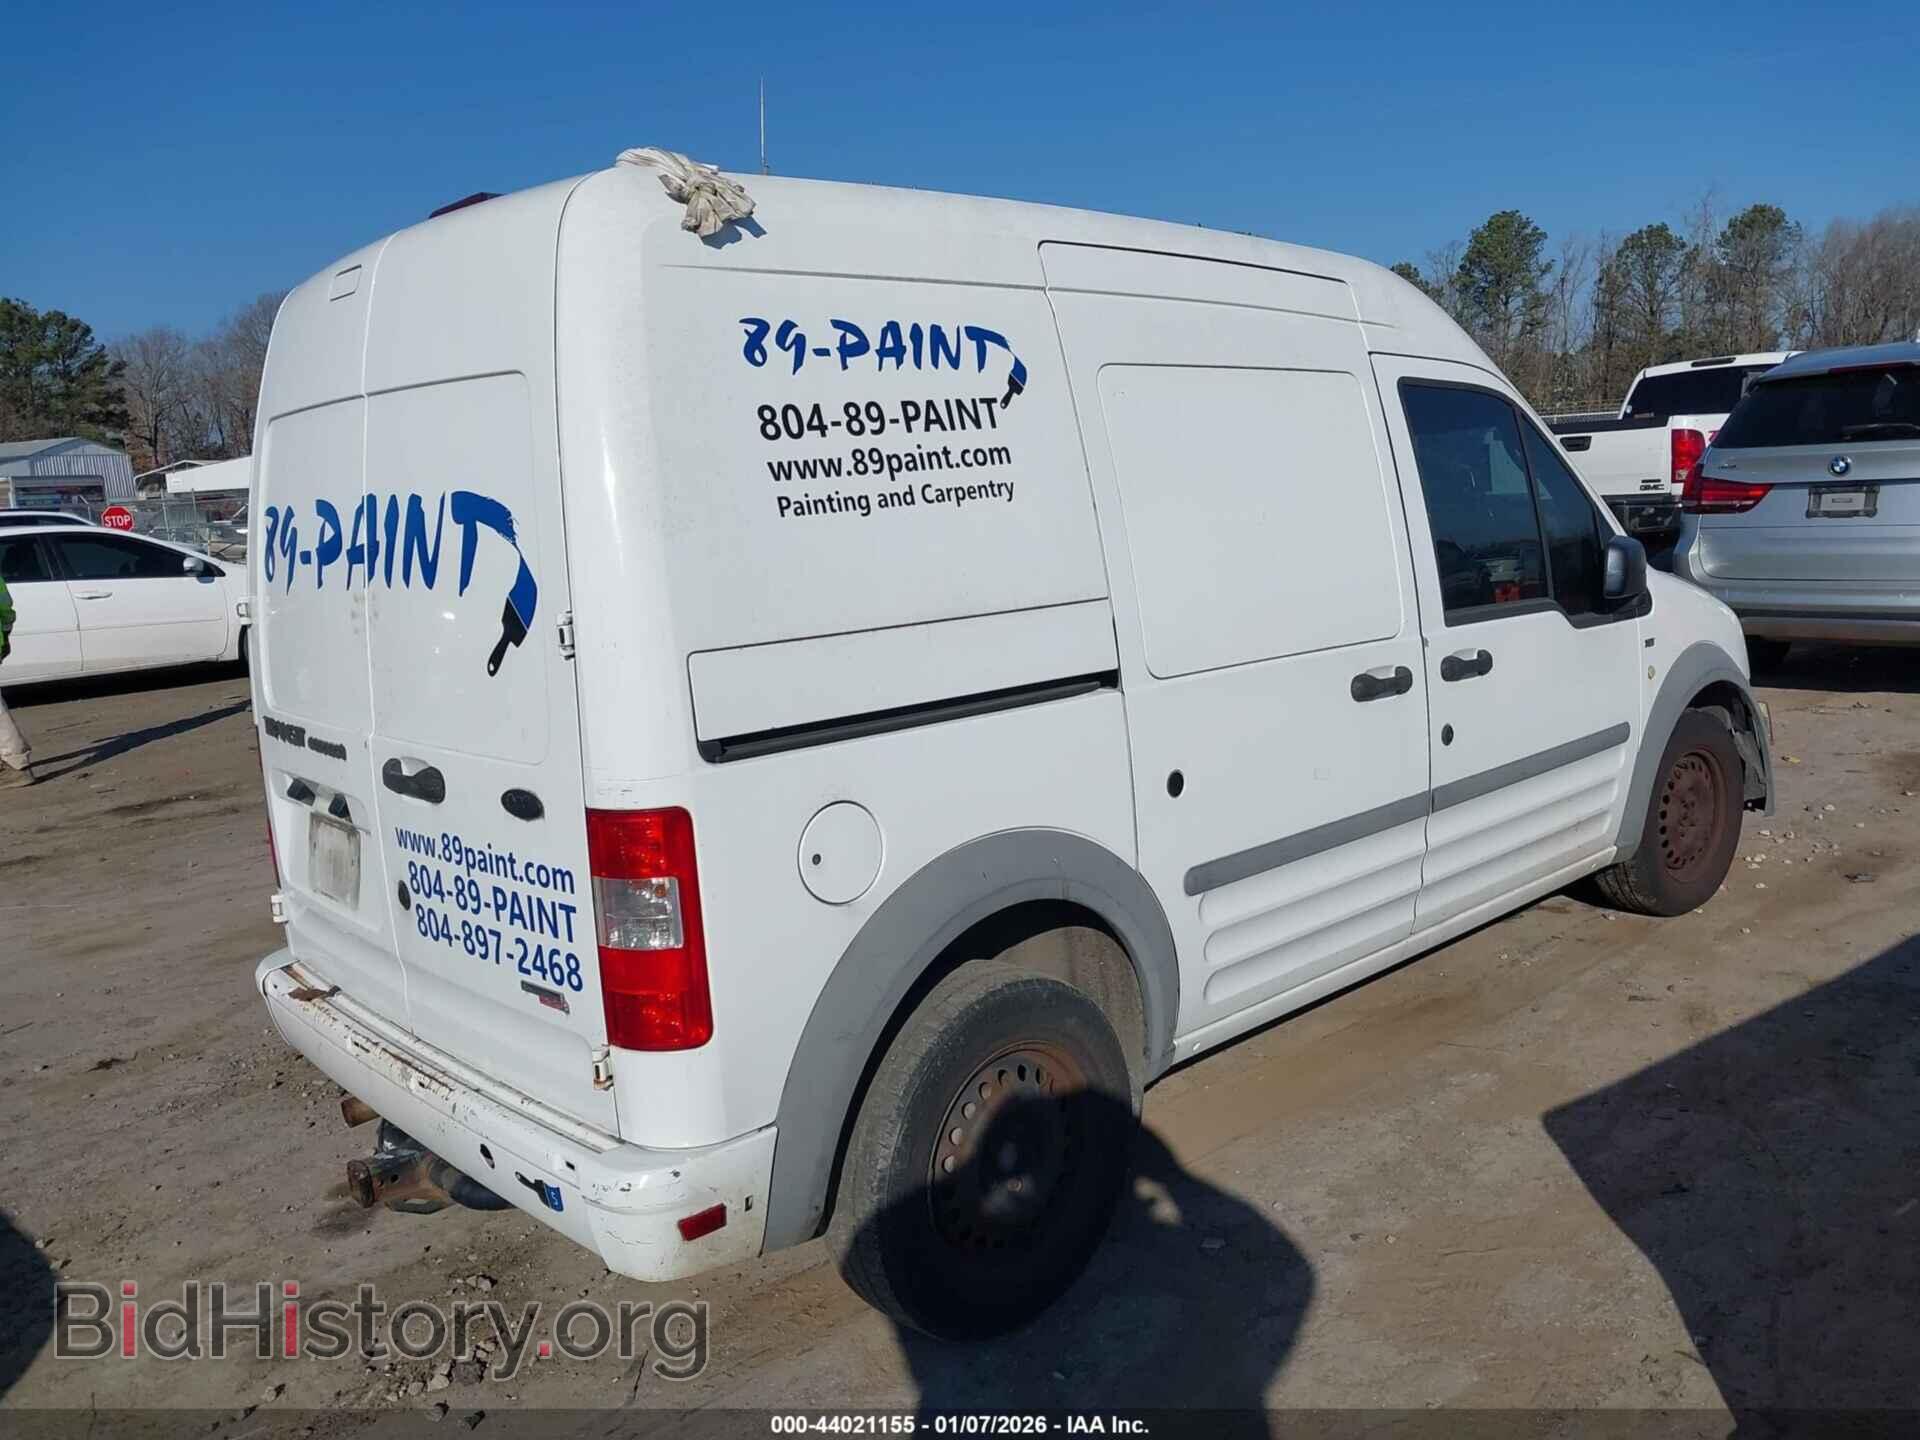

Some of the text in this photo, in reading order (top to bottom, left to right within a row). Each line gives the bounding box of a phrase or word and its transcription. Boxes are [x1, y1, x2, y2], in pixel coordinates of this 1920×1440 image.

[739, 317, 1014, 374] 89-PAINT
[758, 397, 998, 441] 804-89-PAINT
[766, 446, 1012, 482] www.89paint.com
[104, 514, 131, 527] STOP
[776, 481, 1014, 518] Painting and Carpentry
[265, 489, 519, 600] 89-PAINT
[395, 828, 576, 896] www.89paint.com
[407, 857, 578, 945] 804-89-PAINT
[415, 902, 584, 993] 804-897-2468
